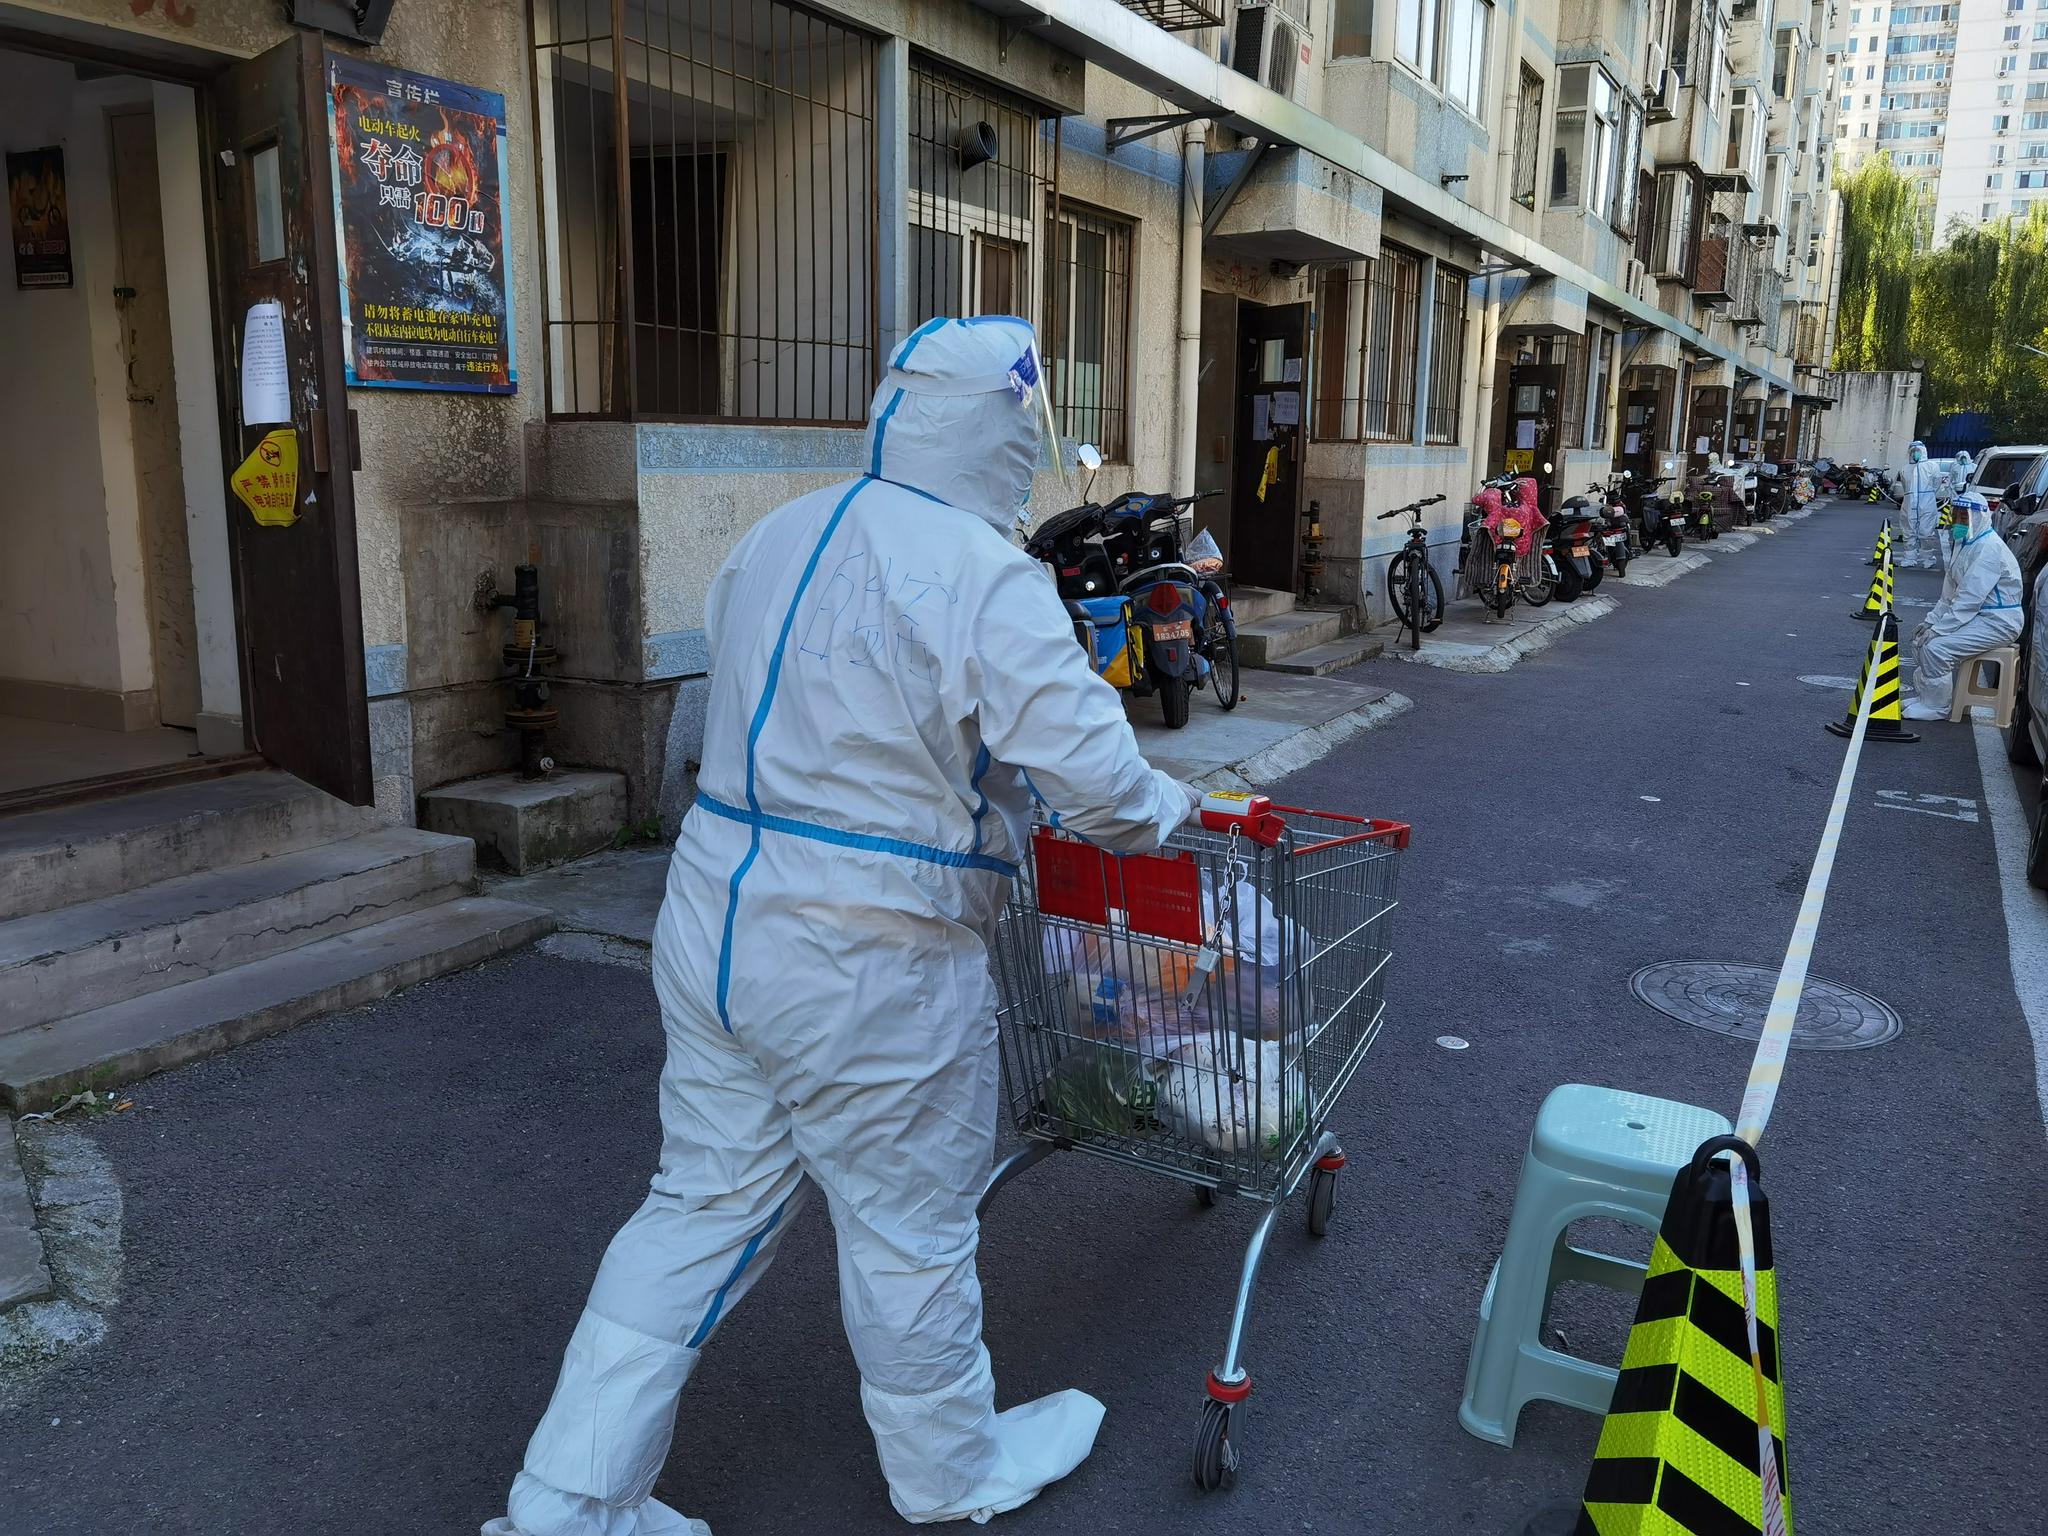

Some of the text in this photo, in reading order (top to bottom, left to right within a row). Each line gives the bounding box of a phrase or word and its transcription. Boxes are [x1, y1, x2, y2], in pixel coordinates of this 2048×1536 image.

[386, 79, 440, 104] 宣传栏
[358, 115, 421, 142] 电动车起火
[360, 138, 424, 187] 夺命
[363, 303, 498, 328] 请勿将蓄电池在家中充电！
[365, 322, 499, 345] 不得从室内拉电线为电动自行车充电！
